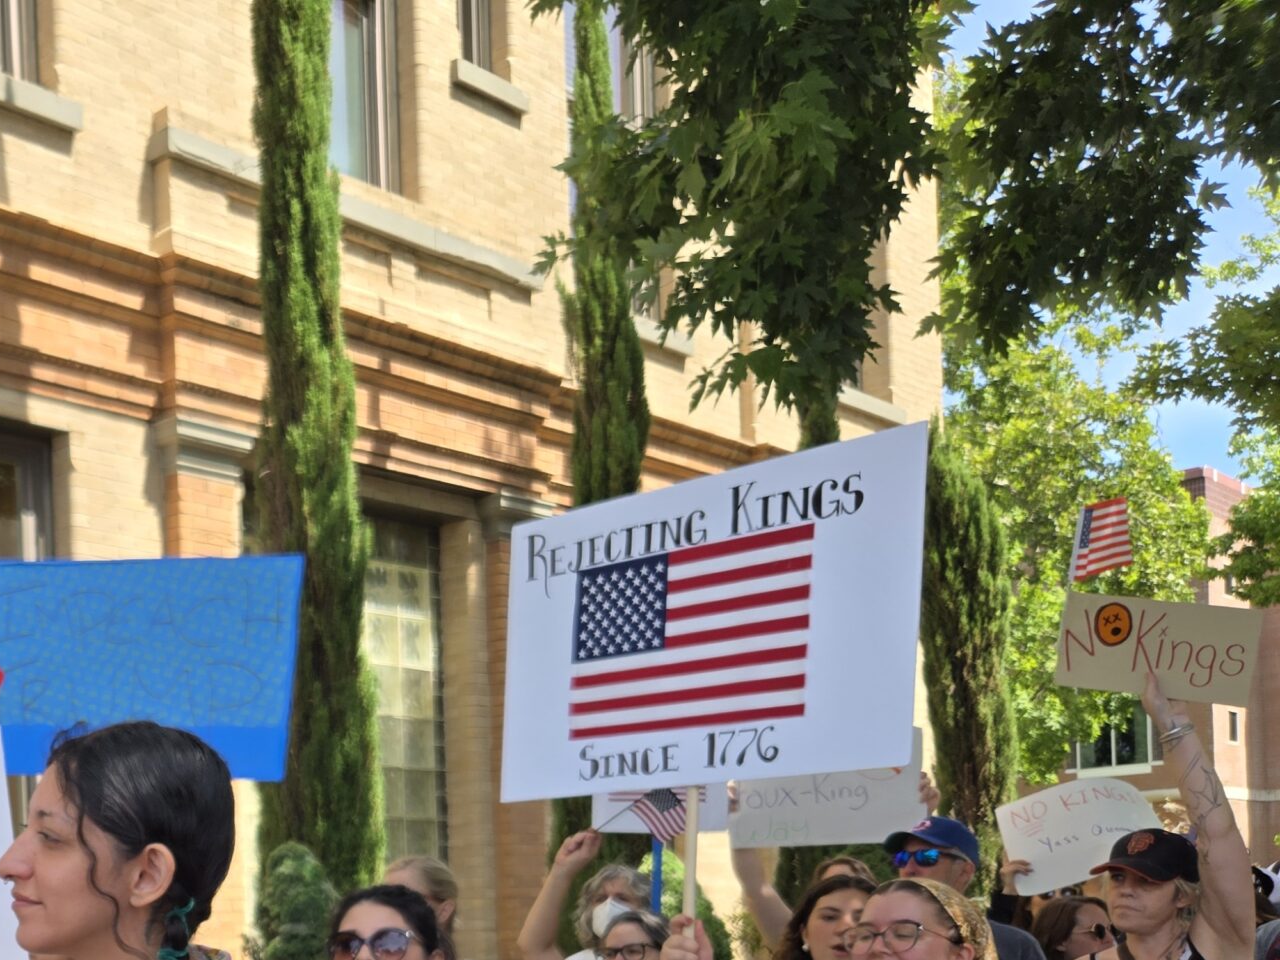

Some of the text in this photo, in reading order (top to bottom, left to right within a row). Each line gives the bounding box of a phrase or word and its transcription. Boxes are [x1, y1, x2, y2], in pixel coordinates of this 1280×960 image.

[525, 470, 865, 599] REJECTING KINGS
[1063, 601, 1246, 688] NO Kings
[578, 725, 780, 782] SINCE 1776
[1010, 799, 1048, 830] NO
